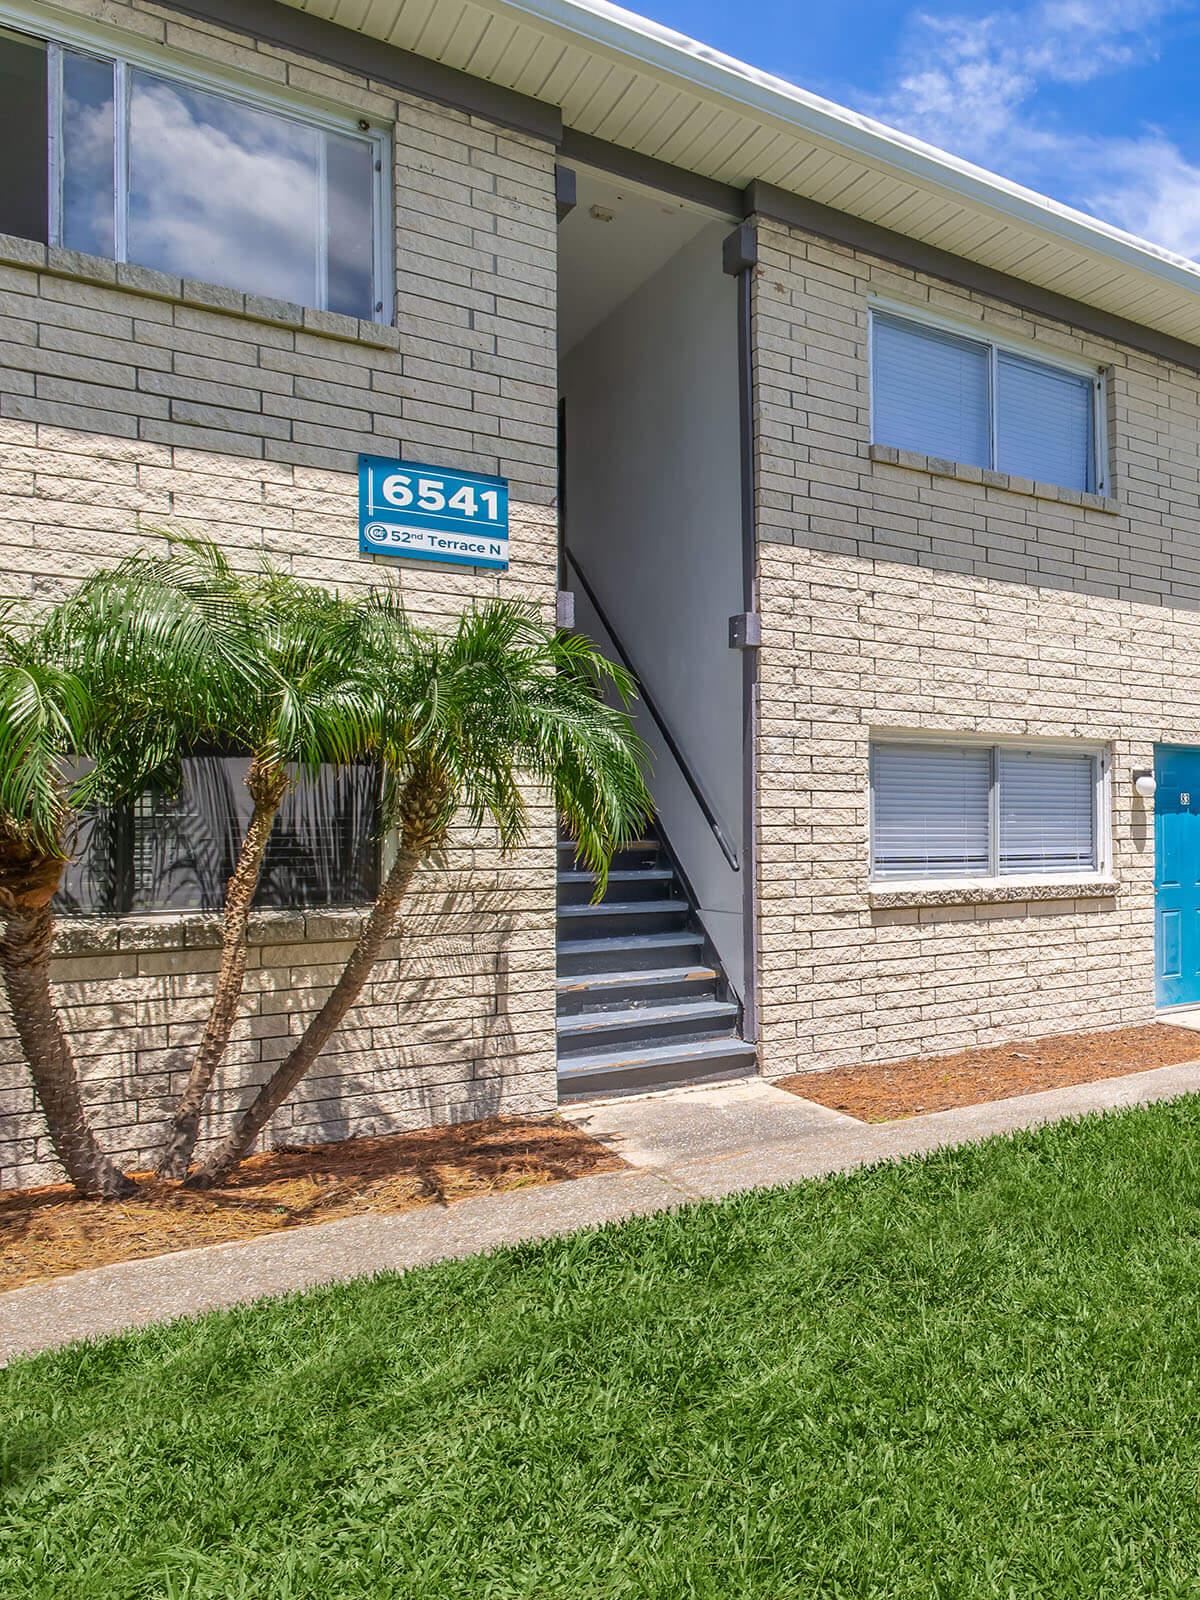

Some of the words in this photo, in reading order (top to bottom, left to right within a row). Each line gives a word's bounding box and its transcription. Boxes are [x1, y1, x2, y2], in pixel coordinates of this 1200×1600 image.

[382, 474, 498, 521] 6541
[391, 530, 423, 544] 52nd
[428, 535, 486, 553] Terrace
[489, 543, 501, 555] N
